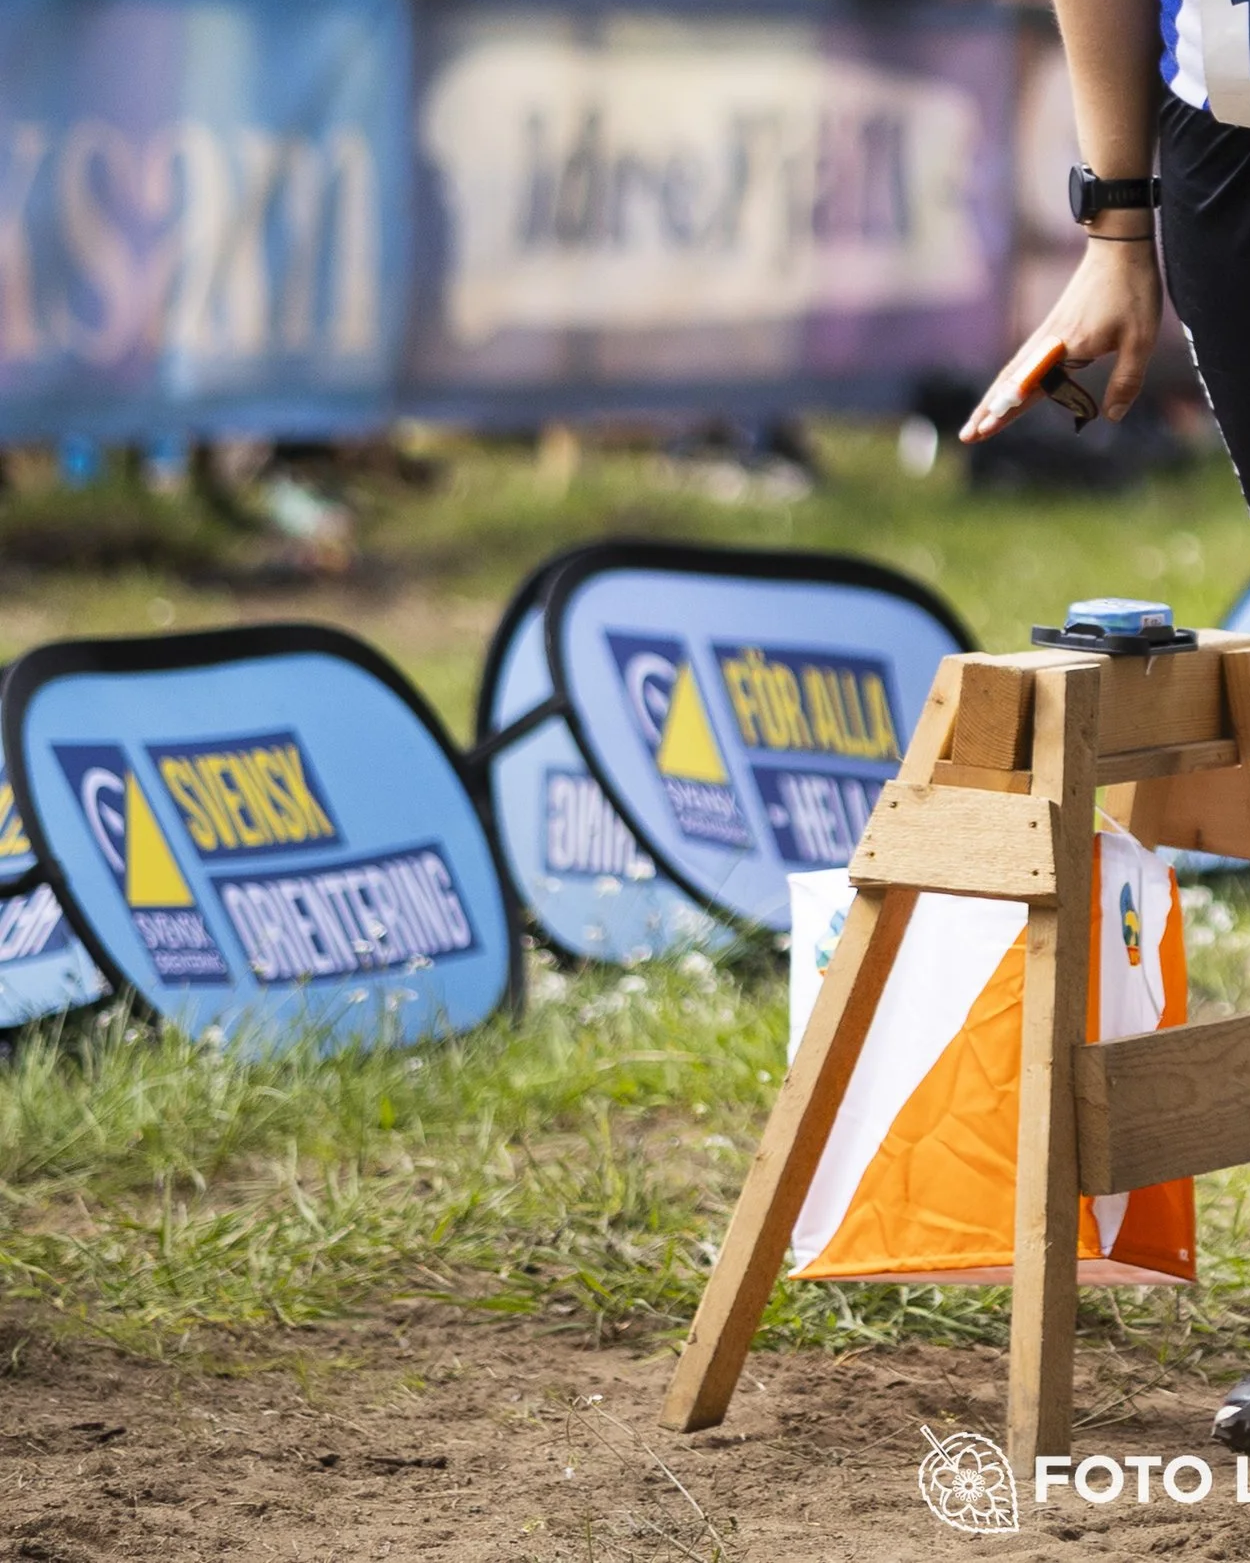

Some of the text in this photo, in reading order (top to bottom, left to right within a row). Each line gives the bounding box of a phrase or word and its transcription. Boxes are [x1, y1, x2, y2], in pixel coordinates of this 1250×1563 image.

[723, 646, 898, 759] FÖR ALLA
[159, 745, 335, 852] SVENSK
[220, 852, 471, 980] ORIENTERING
